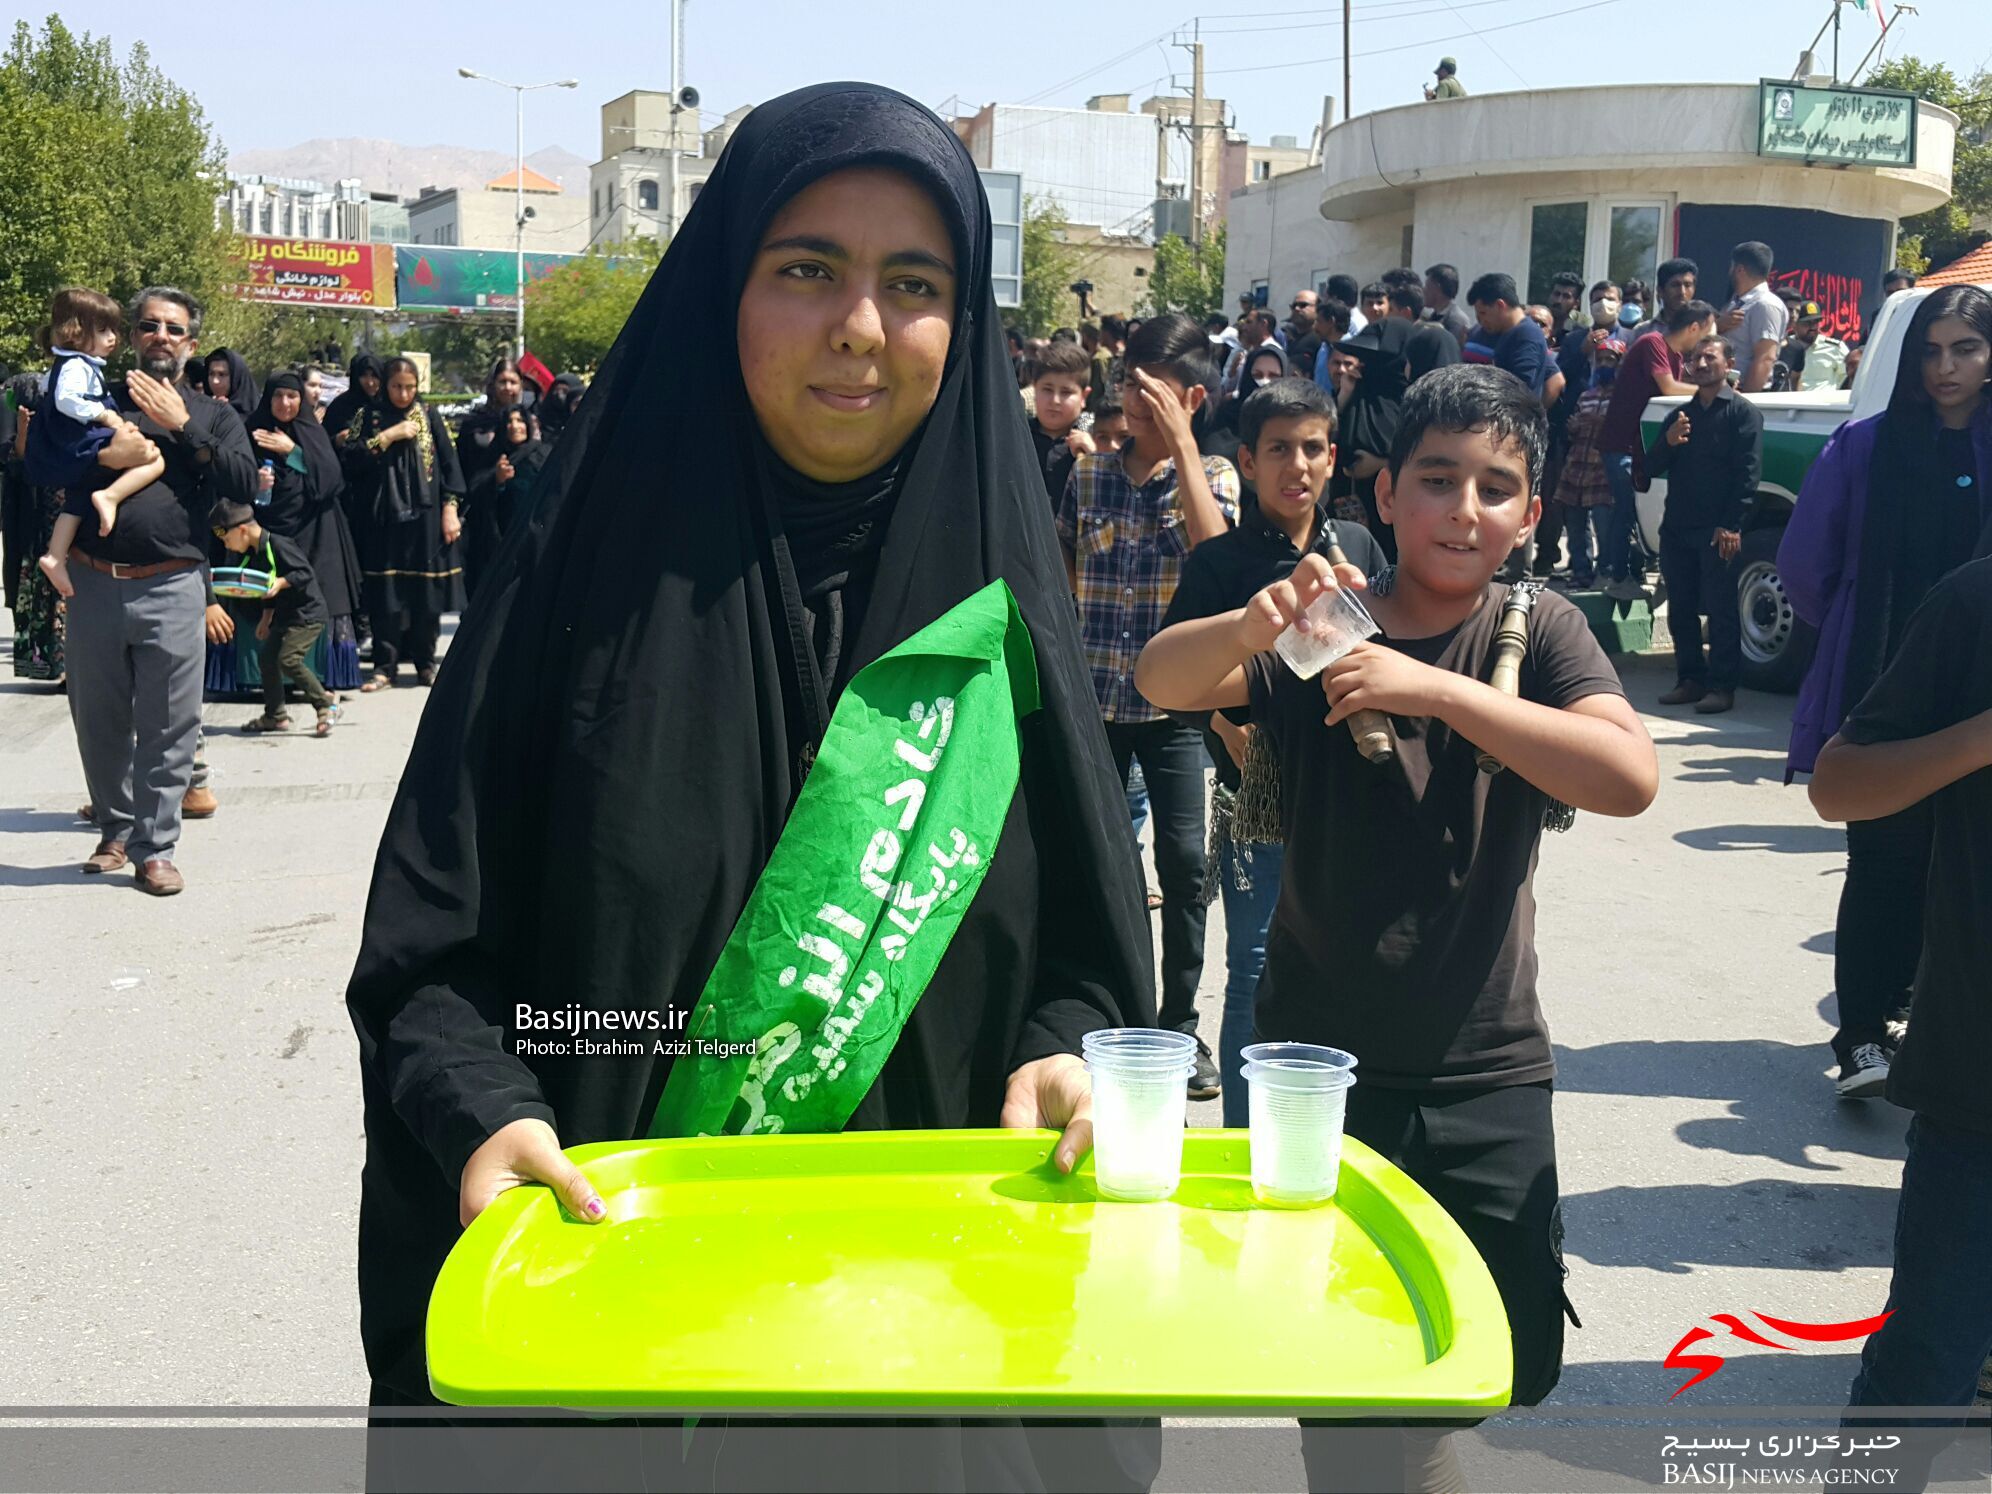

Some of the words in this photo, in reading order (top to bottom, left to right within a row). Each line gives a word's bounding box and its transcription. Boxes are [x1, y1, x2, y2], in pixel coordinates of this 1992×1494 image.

[271, 239, 360, 267] فروشگاه
[276, 271, 308, 284] خانگی
[310, 274, 339, 287] لوازم
[859, 696, 955, 900] خادم
[880, 827, 981, 963] پایگاه
